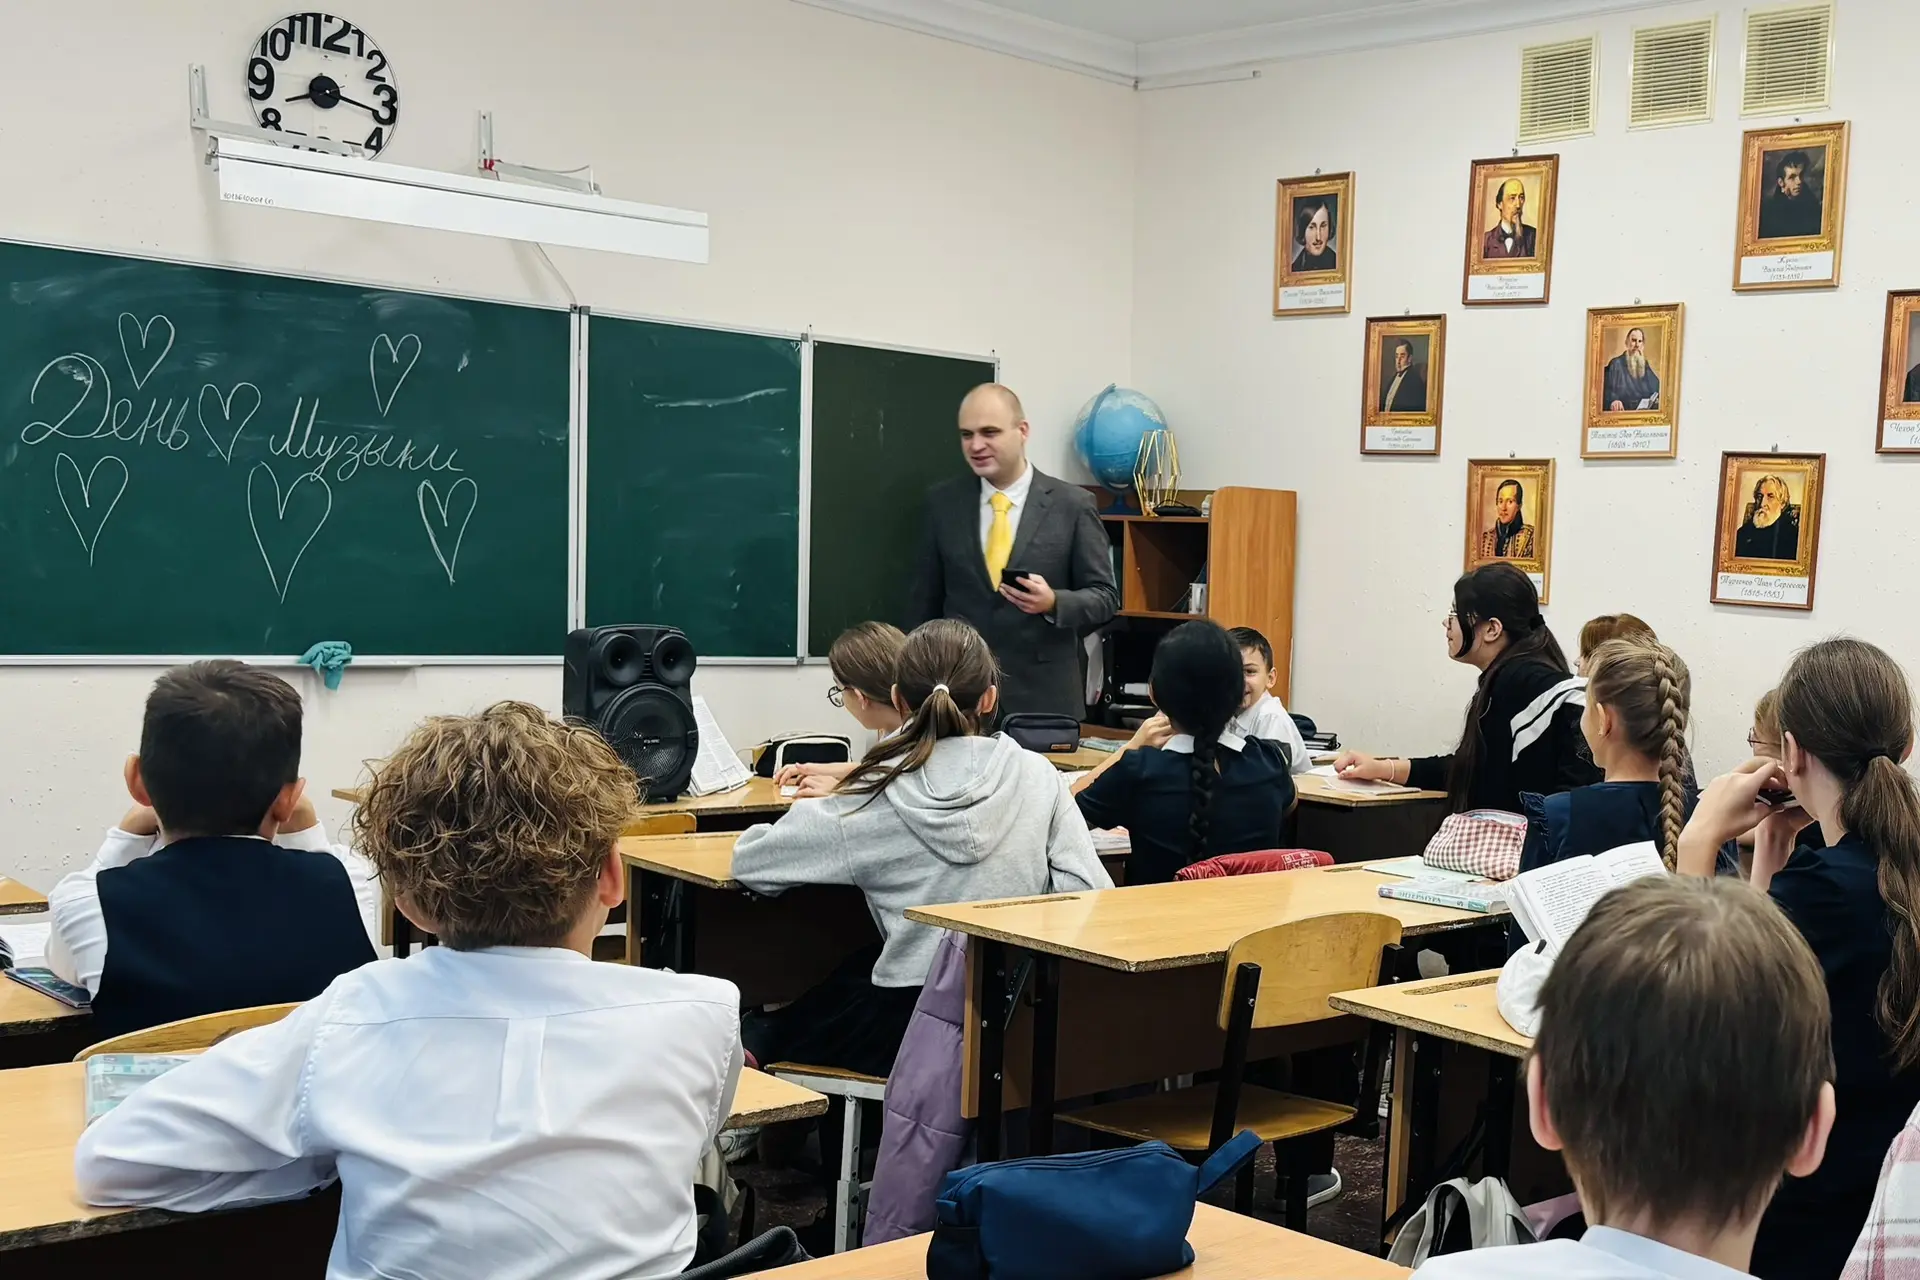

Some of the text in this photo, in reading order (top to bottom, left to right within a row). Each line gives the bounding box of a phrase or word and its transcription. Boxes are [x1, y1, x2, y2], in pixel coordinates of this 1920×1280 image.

[260, 27, 292, 62] 10
[301, 12, 351, 55] 12
[351, 28, 364, 57] 1
[248, 57, 275, 101] 9
[365, 50, 387, 83] 2
[372, 84, 398, 126] 3
[364, 126, 384, 154] 4
[21, 352, 190, 451] День
